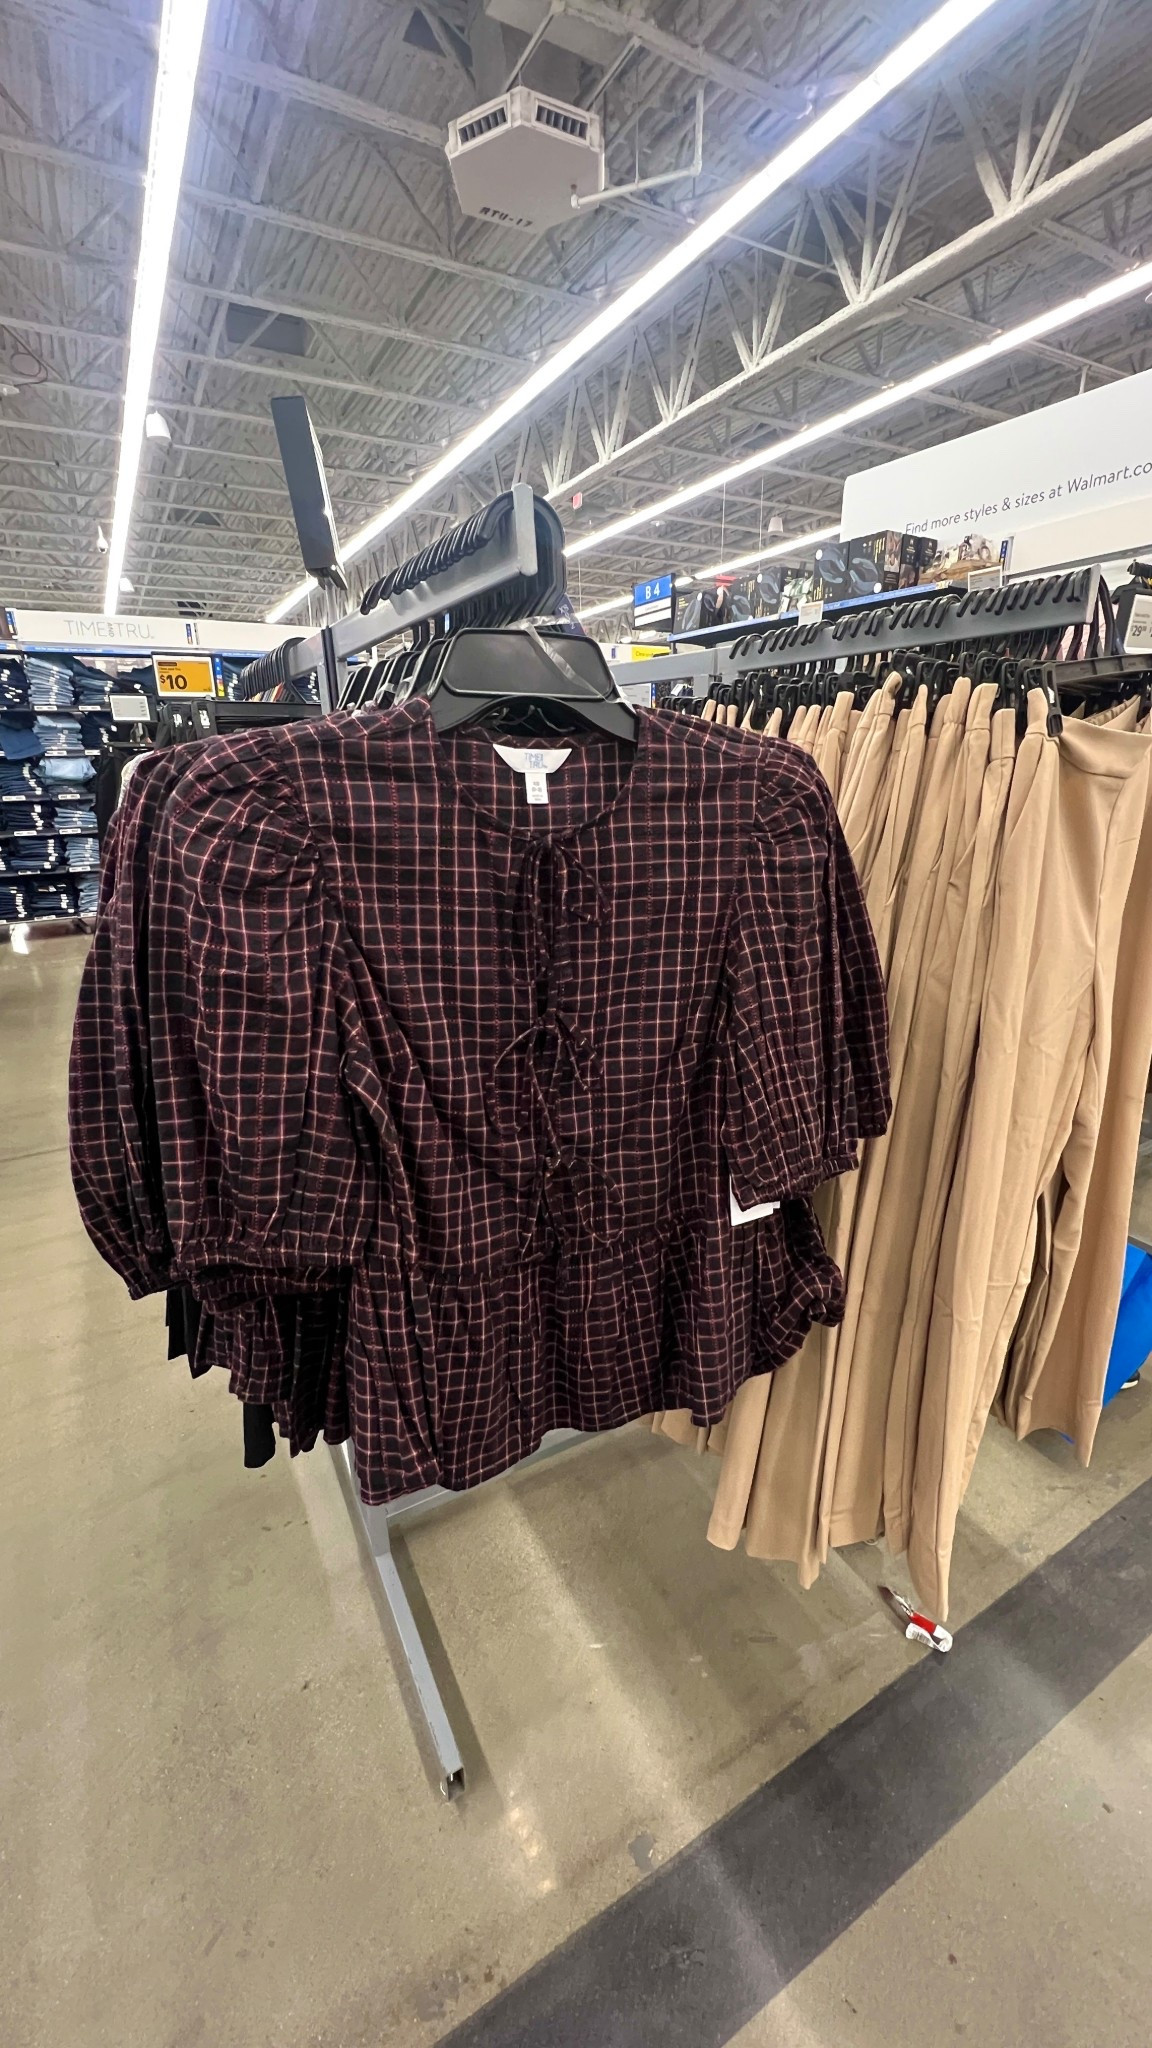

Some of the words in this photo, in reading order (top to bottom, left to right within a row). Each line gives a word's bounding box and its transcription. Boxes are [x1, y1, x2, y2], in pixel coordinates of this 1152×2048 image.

[479, 206, 533, 228] RTU-17
[905, 519, 928, 534] Find
[931, 514, 960, 529] more
[963, 503, 998, 522] styles
[1001, 497, 1011, 511] &
[1014, 491, 1045, 508] sizes
[1048, 484, 1062, 499] at
[63, 619, 107, 637] TIME
[114, 622, 151, 639] TRU
[160, 674, 188, 690] $10
